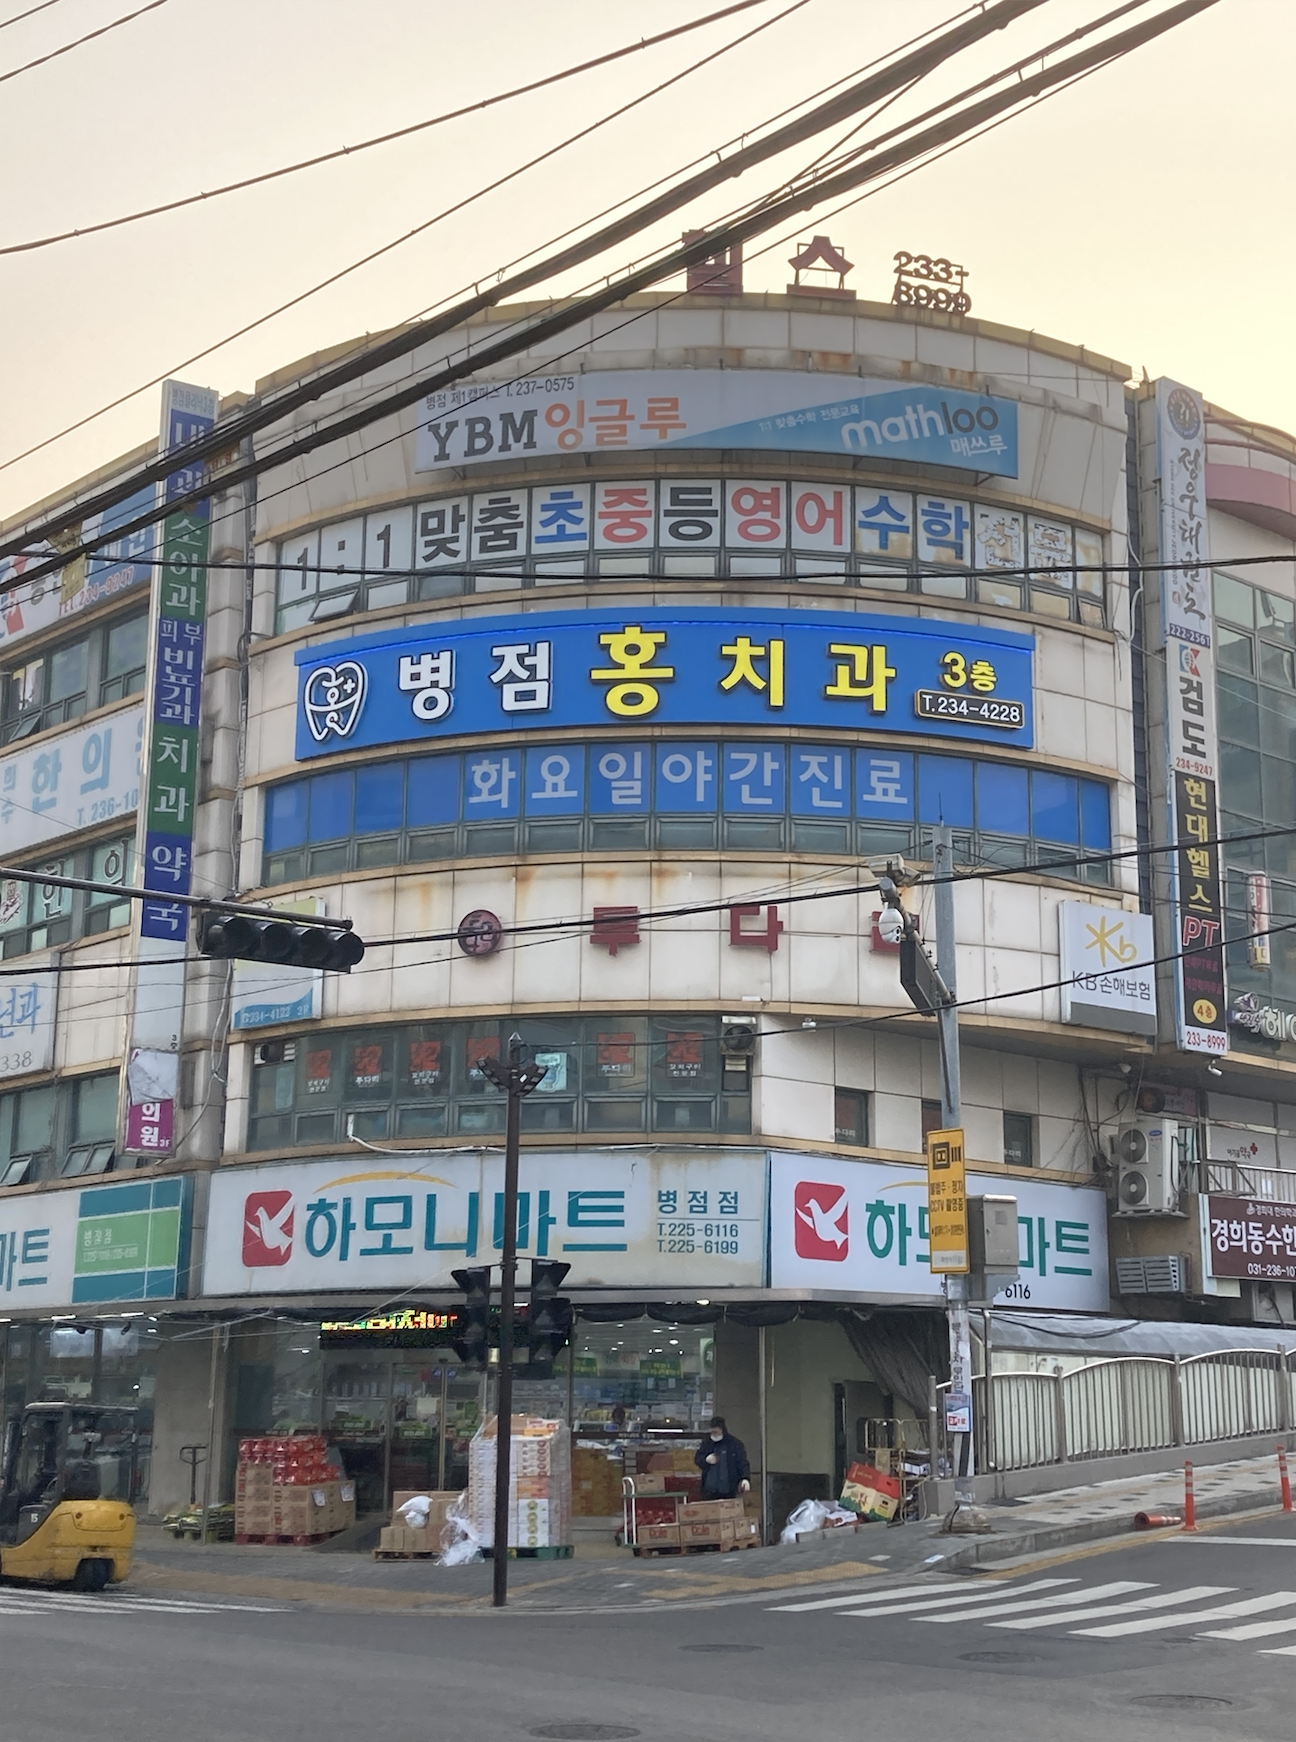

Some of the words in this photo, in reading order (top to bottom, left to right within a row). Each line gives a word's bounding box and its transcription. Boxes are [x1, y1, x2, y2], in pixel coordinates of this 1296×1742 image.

[820, 404, 860, 420] 전문교육
[428, 409, 538, 463] YBM
[544, 397, 687, 451] 잉글루
[841, 402, 999, 449] mathloo
[949, 434, 1008, 457] 매쓰루
[1169, 624, 1210, 646] 222-2561
[942, 651, 998, 692] 3층
[922, 694, 1022, 723] T.234-4228
[1179, 676, 1206, 759] 검도
[153, 735, 190, 822] 치과
[1176, 757, 1213, 776] 234-9247
[146, 845, 188, 931] 약국
[1182, 915, 1221, 951] PT
[1186, 1030, 1226, 1051] 233-8999
[657, 1189, 739, 1214] 병점점
[657, 1222, 739, 1238] T.225-6116
[657, 1238, 739, 1255] T.225-6199
[1248, 1262, 1296, 1277] 031-236-10
